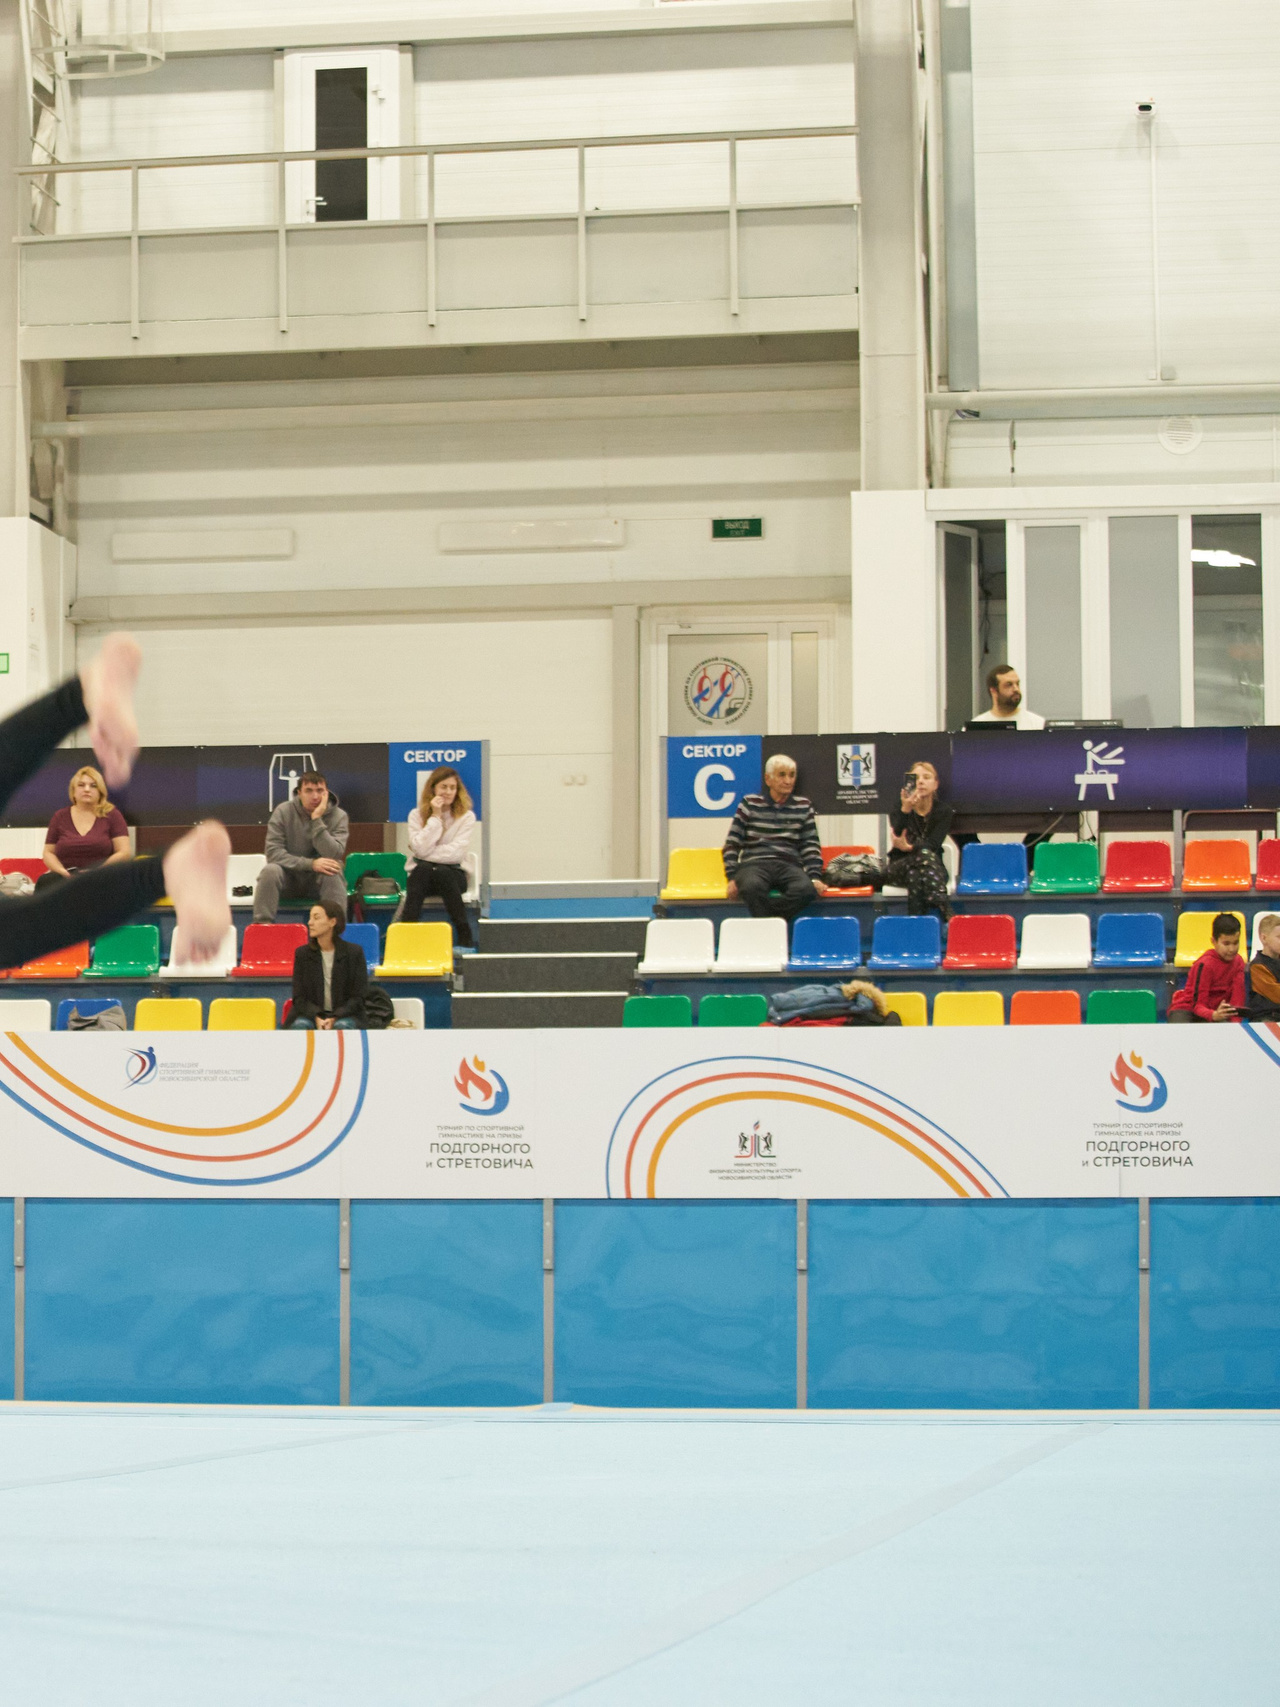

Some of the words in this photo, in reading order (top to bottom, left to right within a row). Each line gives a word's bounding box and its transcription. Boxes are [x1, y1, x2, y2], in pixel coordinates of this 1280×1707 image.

[403, 749, 467, 763] СЕКТОР
[682, 744, 747, 758] СЕКТОР
[429, 1142, 531, 1155] ПОДГОРНОГО
[1086, 1140, 1190, 1153] ПОДГОРНОГО
[436, 1157, 534, 1169] СТРЕТОВИЧА
[1093, 1156, 1194, 1167] СТРЕТОВИЧА
